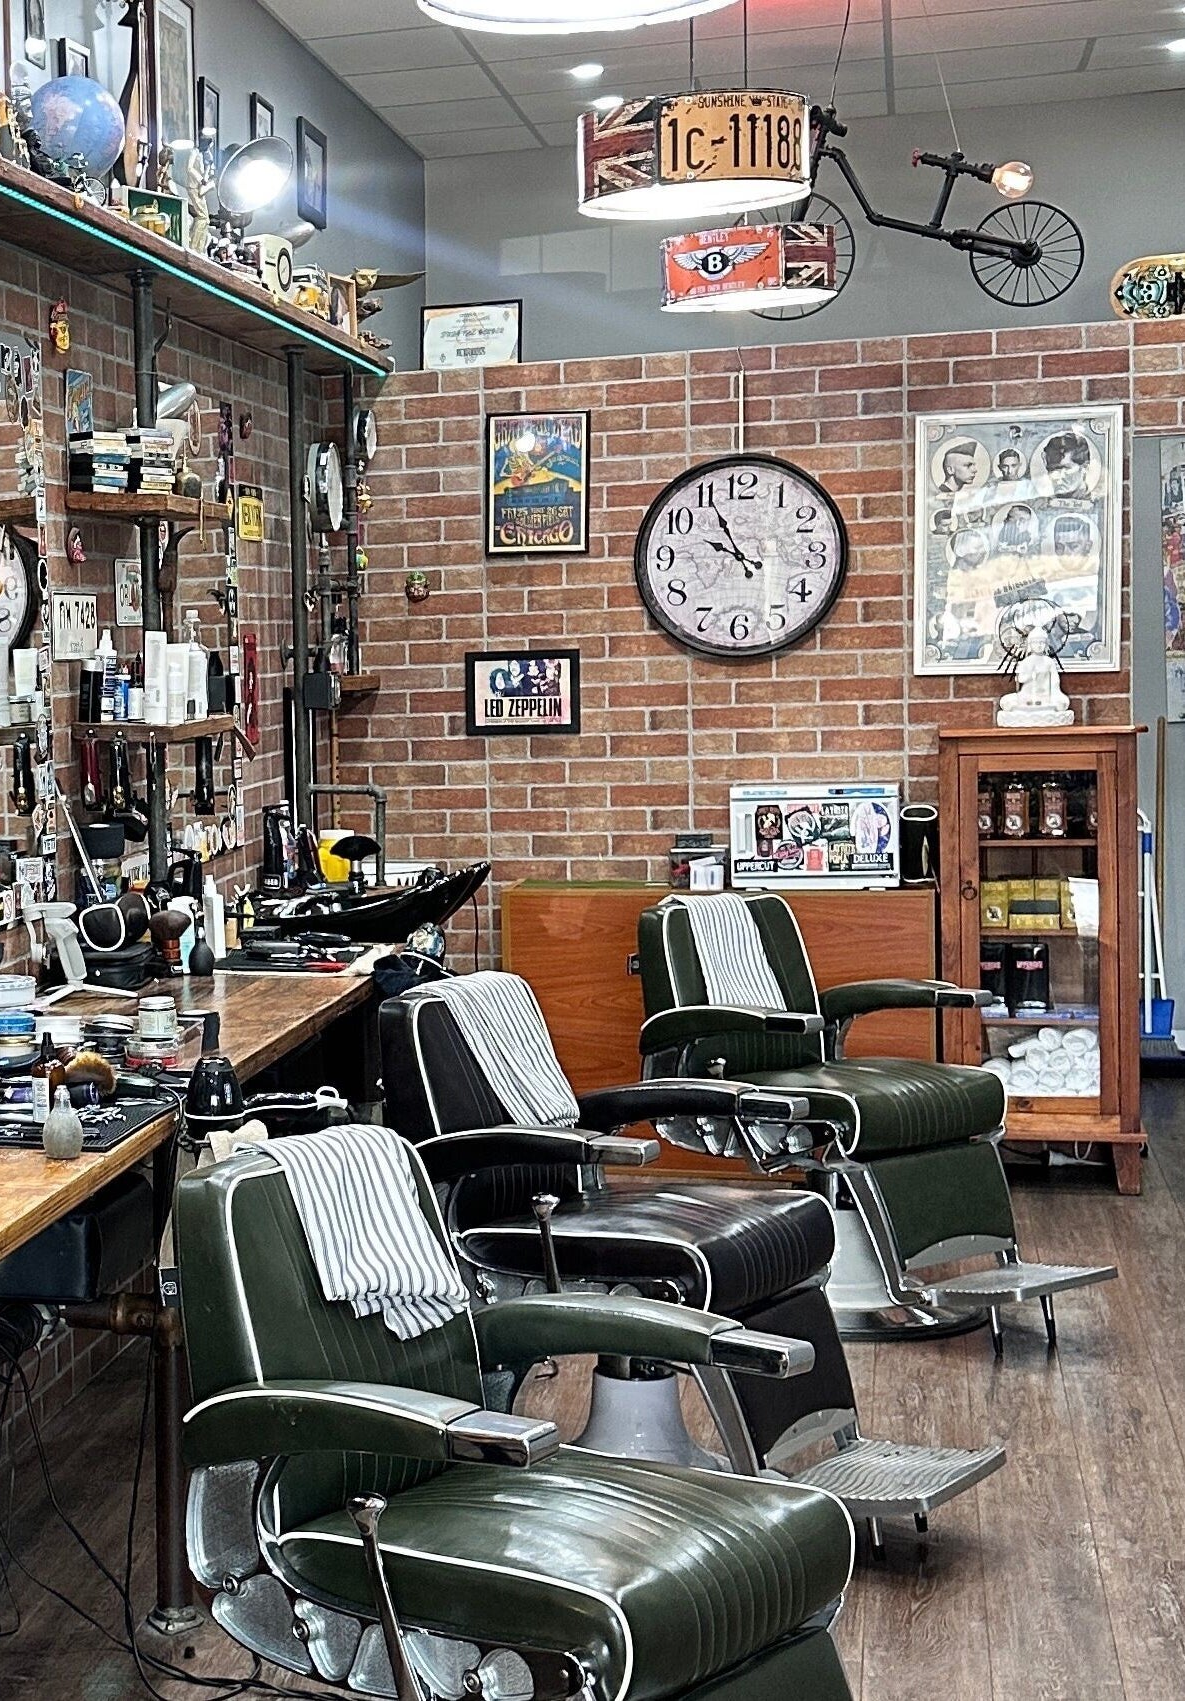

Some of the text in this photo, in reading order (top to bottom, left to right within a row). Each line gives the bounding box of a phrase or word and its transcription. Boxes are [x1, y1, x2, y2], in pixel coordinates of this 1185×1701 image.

[697, 95, 746, 109] SUNSHINE
[707, 253, 723, 272] B
[696, 481, 714, 508] 11
[727, 472, 758, 500] 12
[776, 481, 784, 508] 1
[667, 507, 693, 535] 10
[796, 506, 817, 533] 2
[500, 520, 574, 546] CHICAGO
[656, 545, 675, 571] 9
[806, 541, 827, 570] 3
[666, 579, 687, 606] 8
[789, 578, 812, 603] 4
[695, 607, 713, 633] 7
[729, 614, 749, 641] 6
[766, 604, 786, 631] 5
[485, 698, 562, 717] LED ZEPPELIN
[737, 861, 775, 872] UPPERCUT
[853, 854, 888, 863] DELUXE
